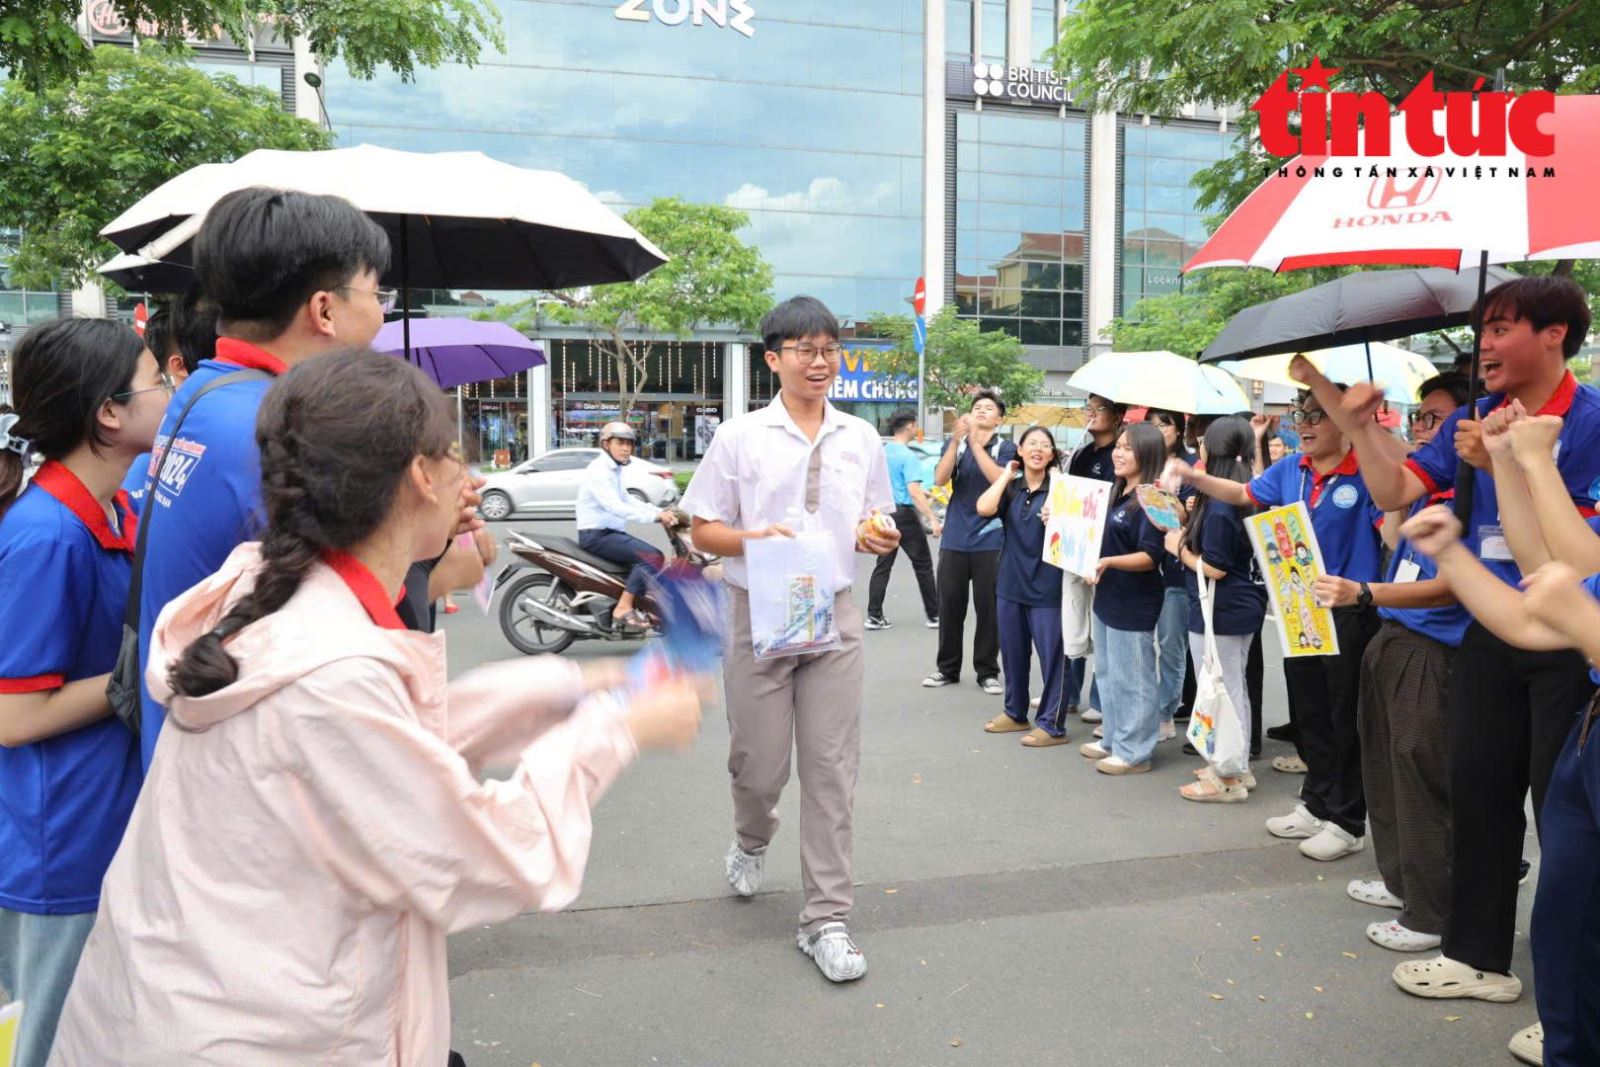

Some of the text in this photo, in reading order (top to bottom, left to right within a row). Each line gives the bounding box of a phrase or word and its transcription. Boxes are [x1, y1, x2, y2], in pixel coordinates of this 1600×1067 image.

[1007, 82, 1074, 102] COUNCIL
[1333, 211, 1453, 228] HONDA
[828, 376, 858, 398] IÊM
